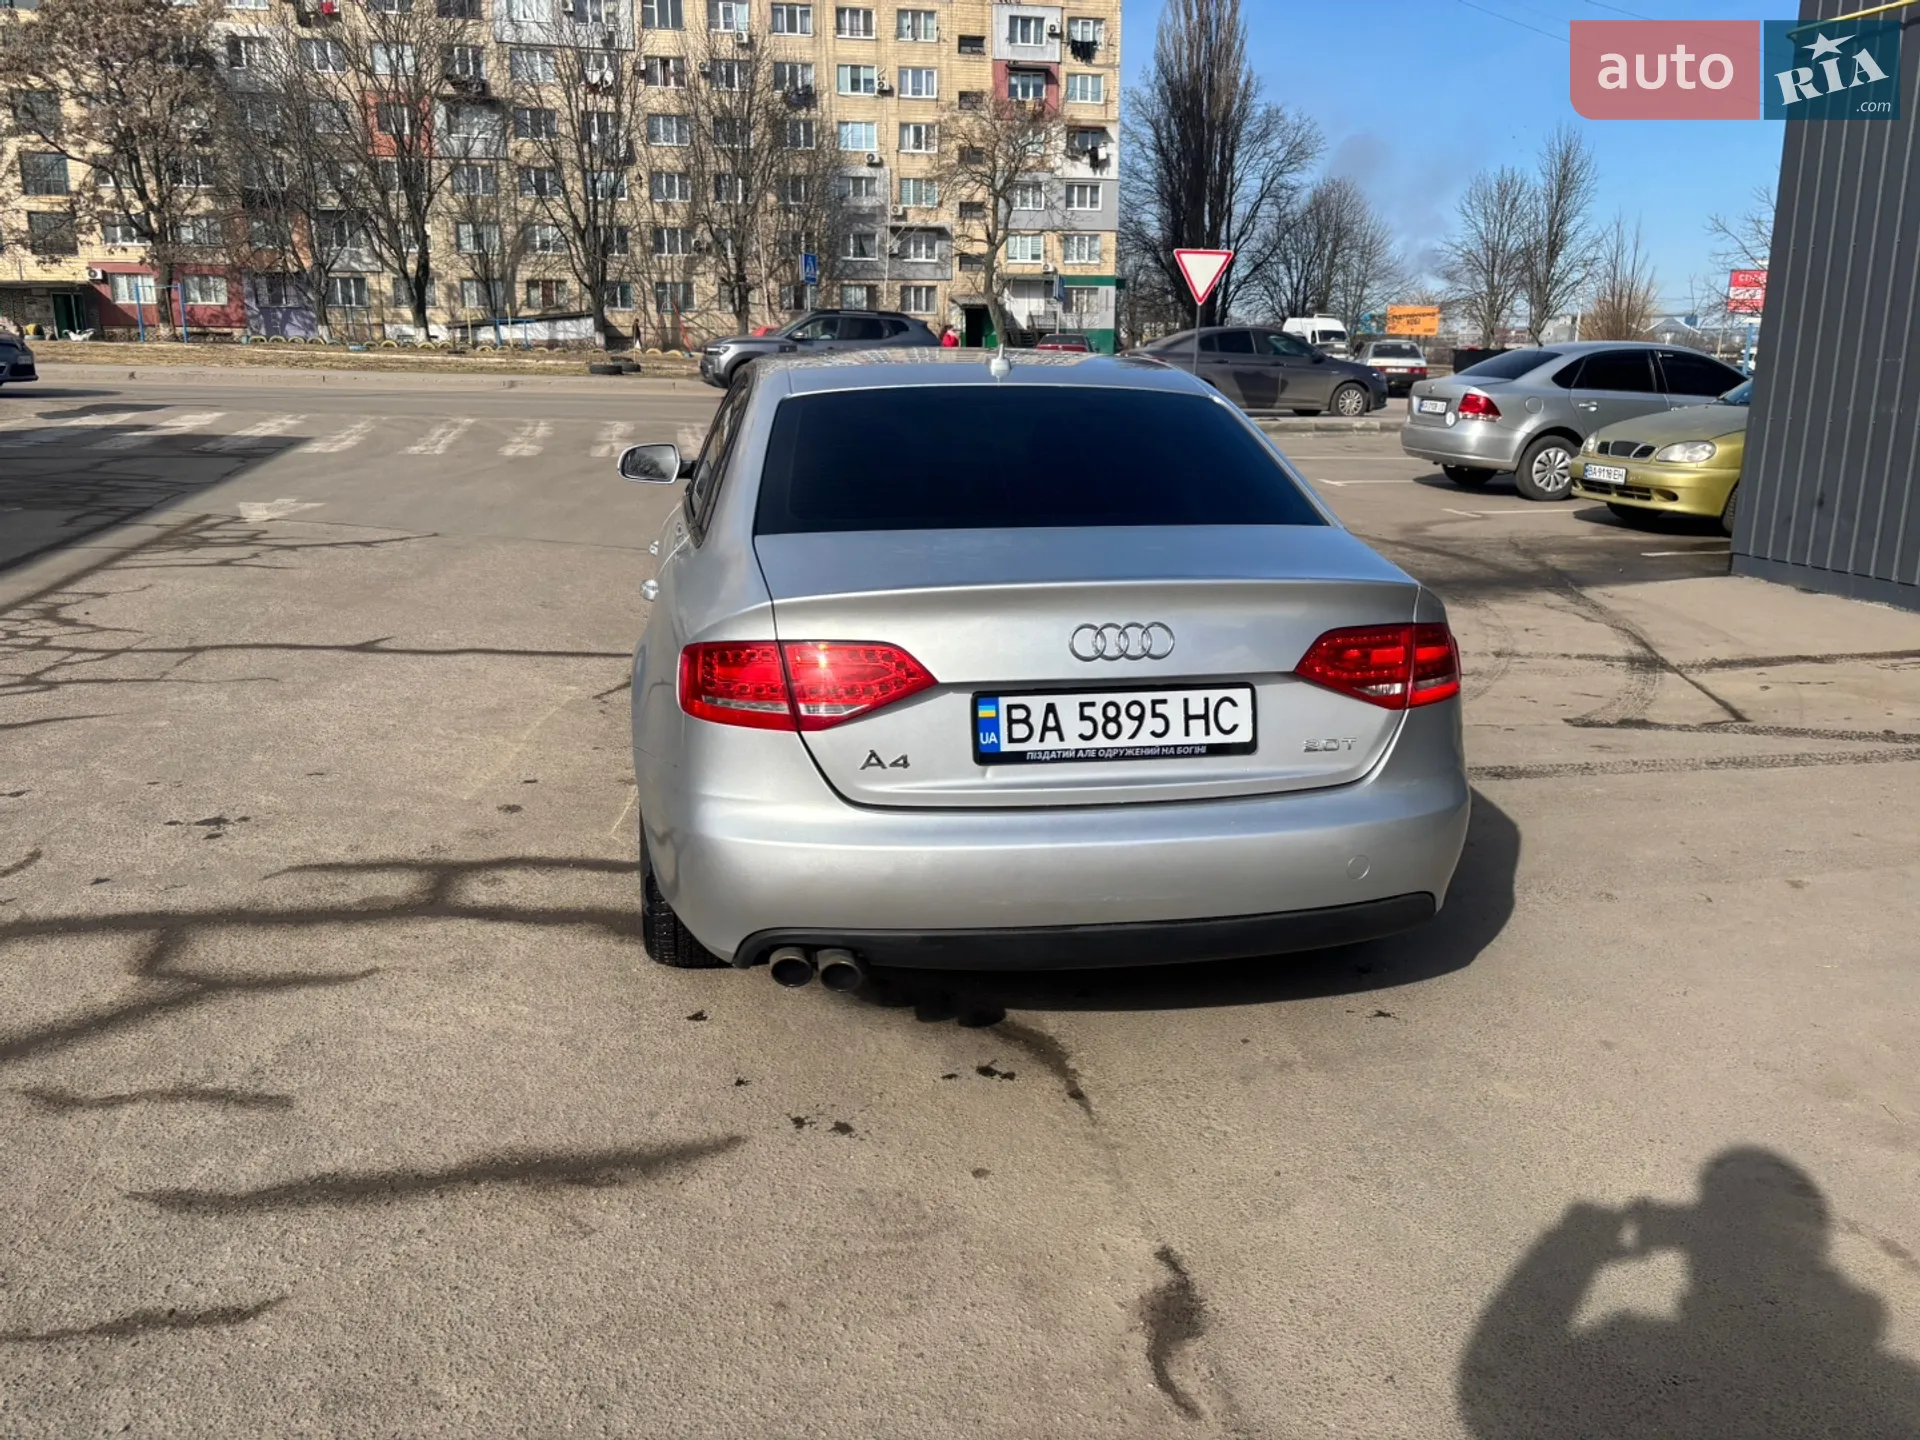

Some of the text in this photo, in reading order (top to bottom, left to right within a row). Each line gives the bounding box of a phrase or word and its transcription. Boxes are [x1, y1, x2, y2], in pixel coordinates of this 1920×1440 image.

[1006, 696, 1240, 744] BA 5895 HC
[980, 731, 999, 744] UA
[860, 749, 911, 770] A4
[1026, 749, 1076, 761] ПІЗДАТИЙ
[1077, 749, 1097, 758] АЛЕ
[1098, 746, 1160, 758] ОДРУЖЕНИЙ
[1161, 746, 1176, 755] НА
